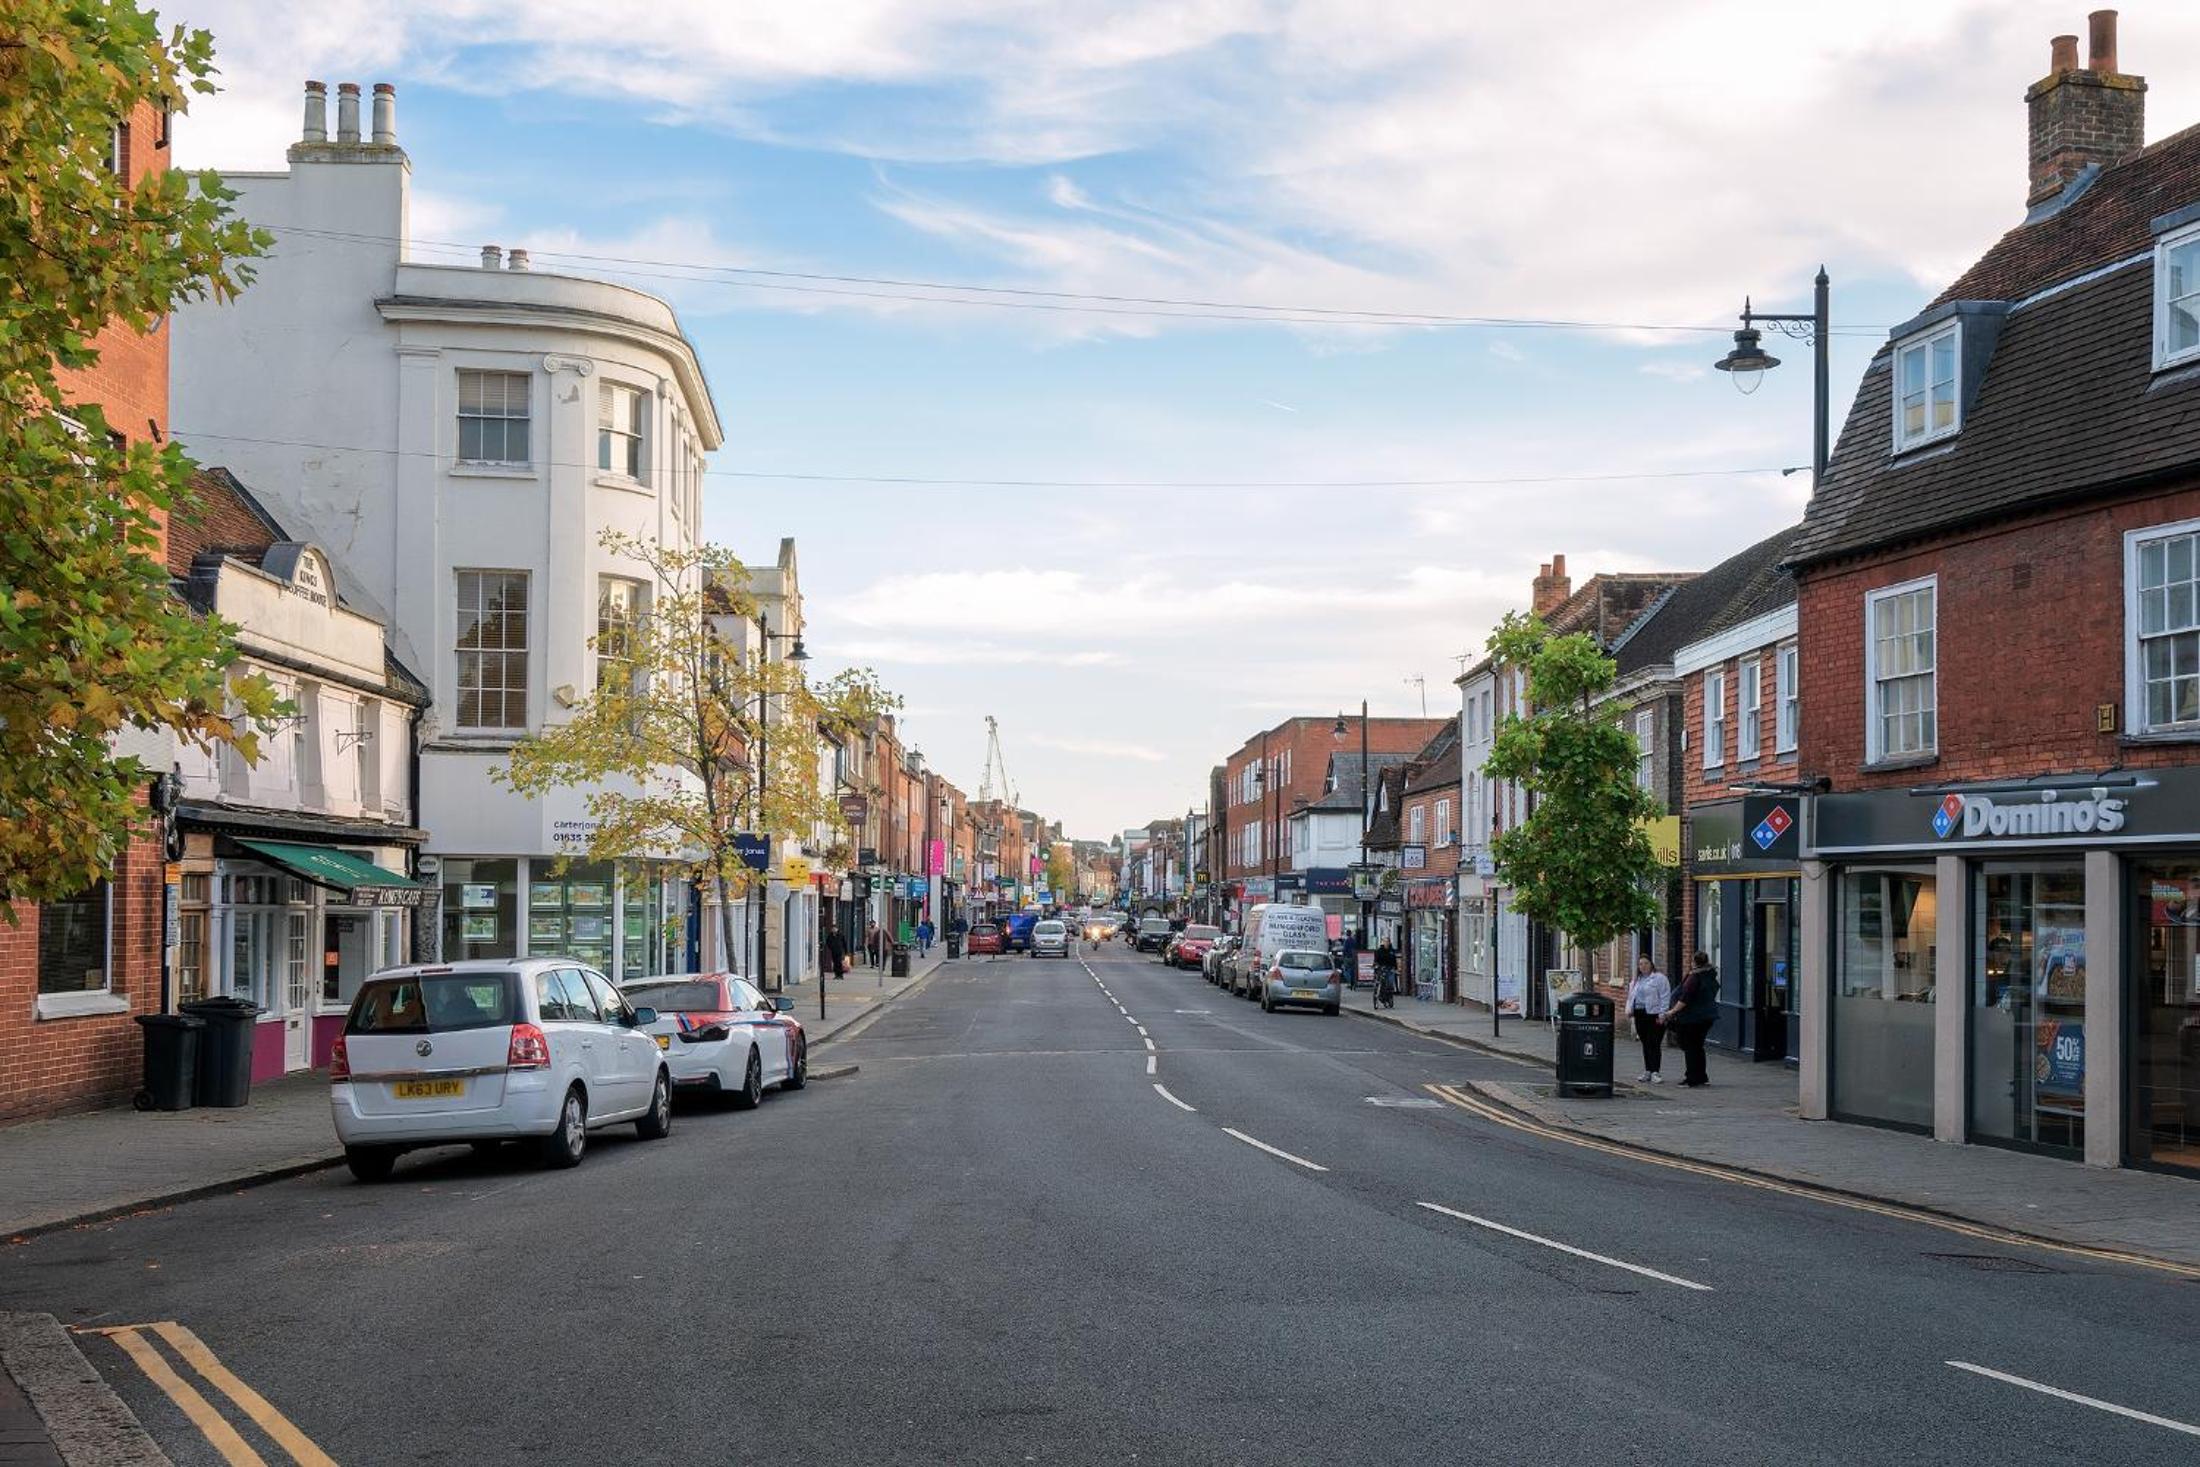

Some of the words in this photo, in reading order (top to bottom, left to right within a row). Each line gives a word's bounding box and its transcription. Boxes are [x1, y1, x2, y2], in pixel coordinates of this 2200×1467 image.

[300, 570, 318, 587] KINGS
[1963, 787, 2125, 837] Domino's
[399, 1083, 432, 1097] LK63
[435, 1081, 460, 1095] URY
